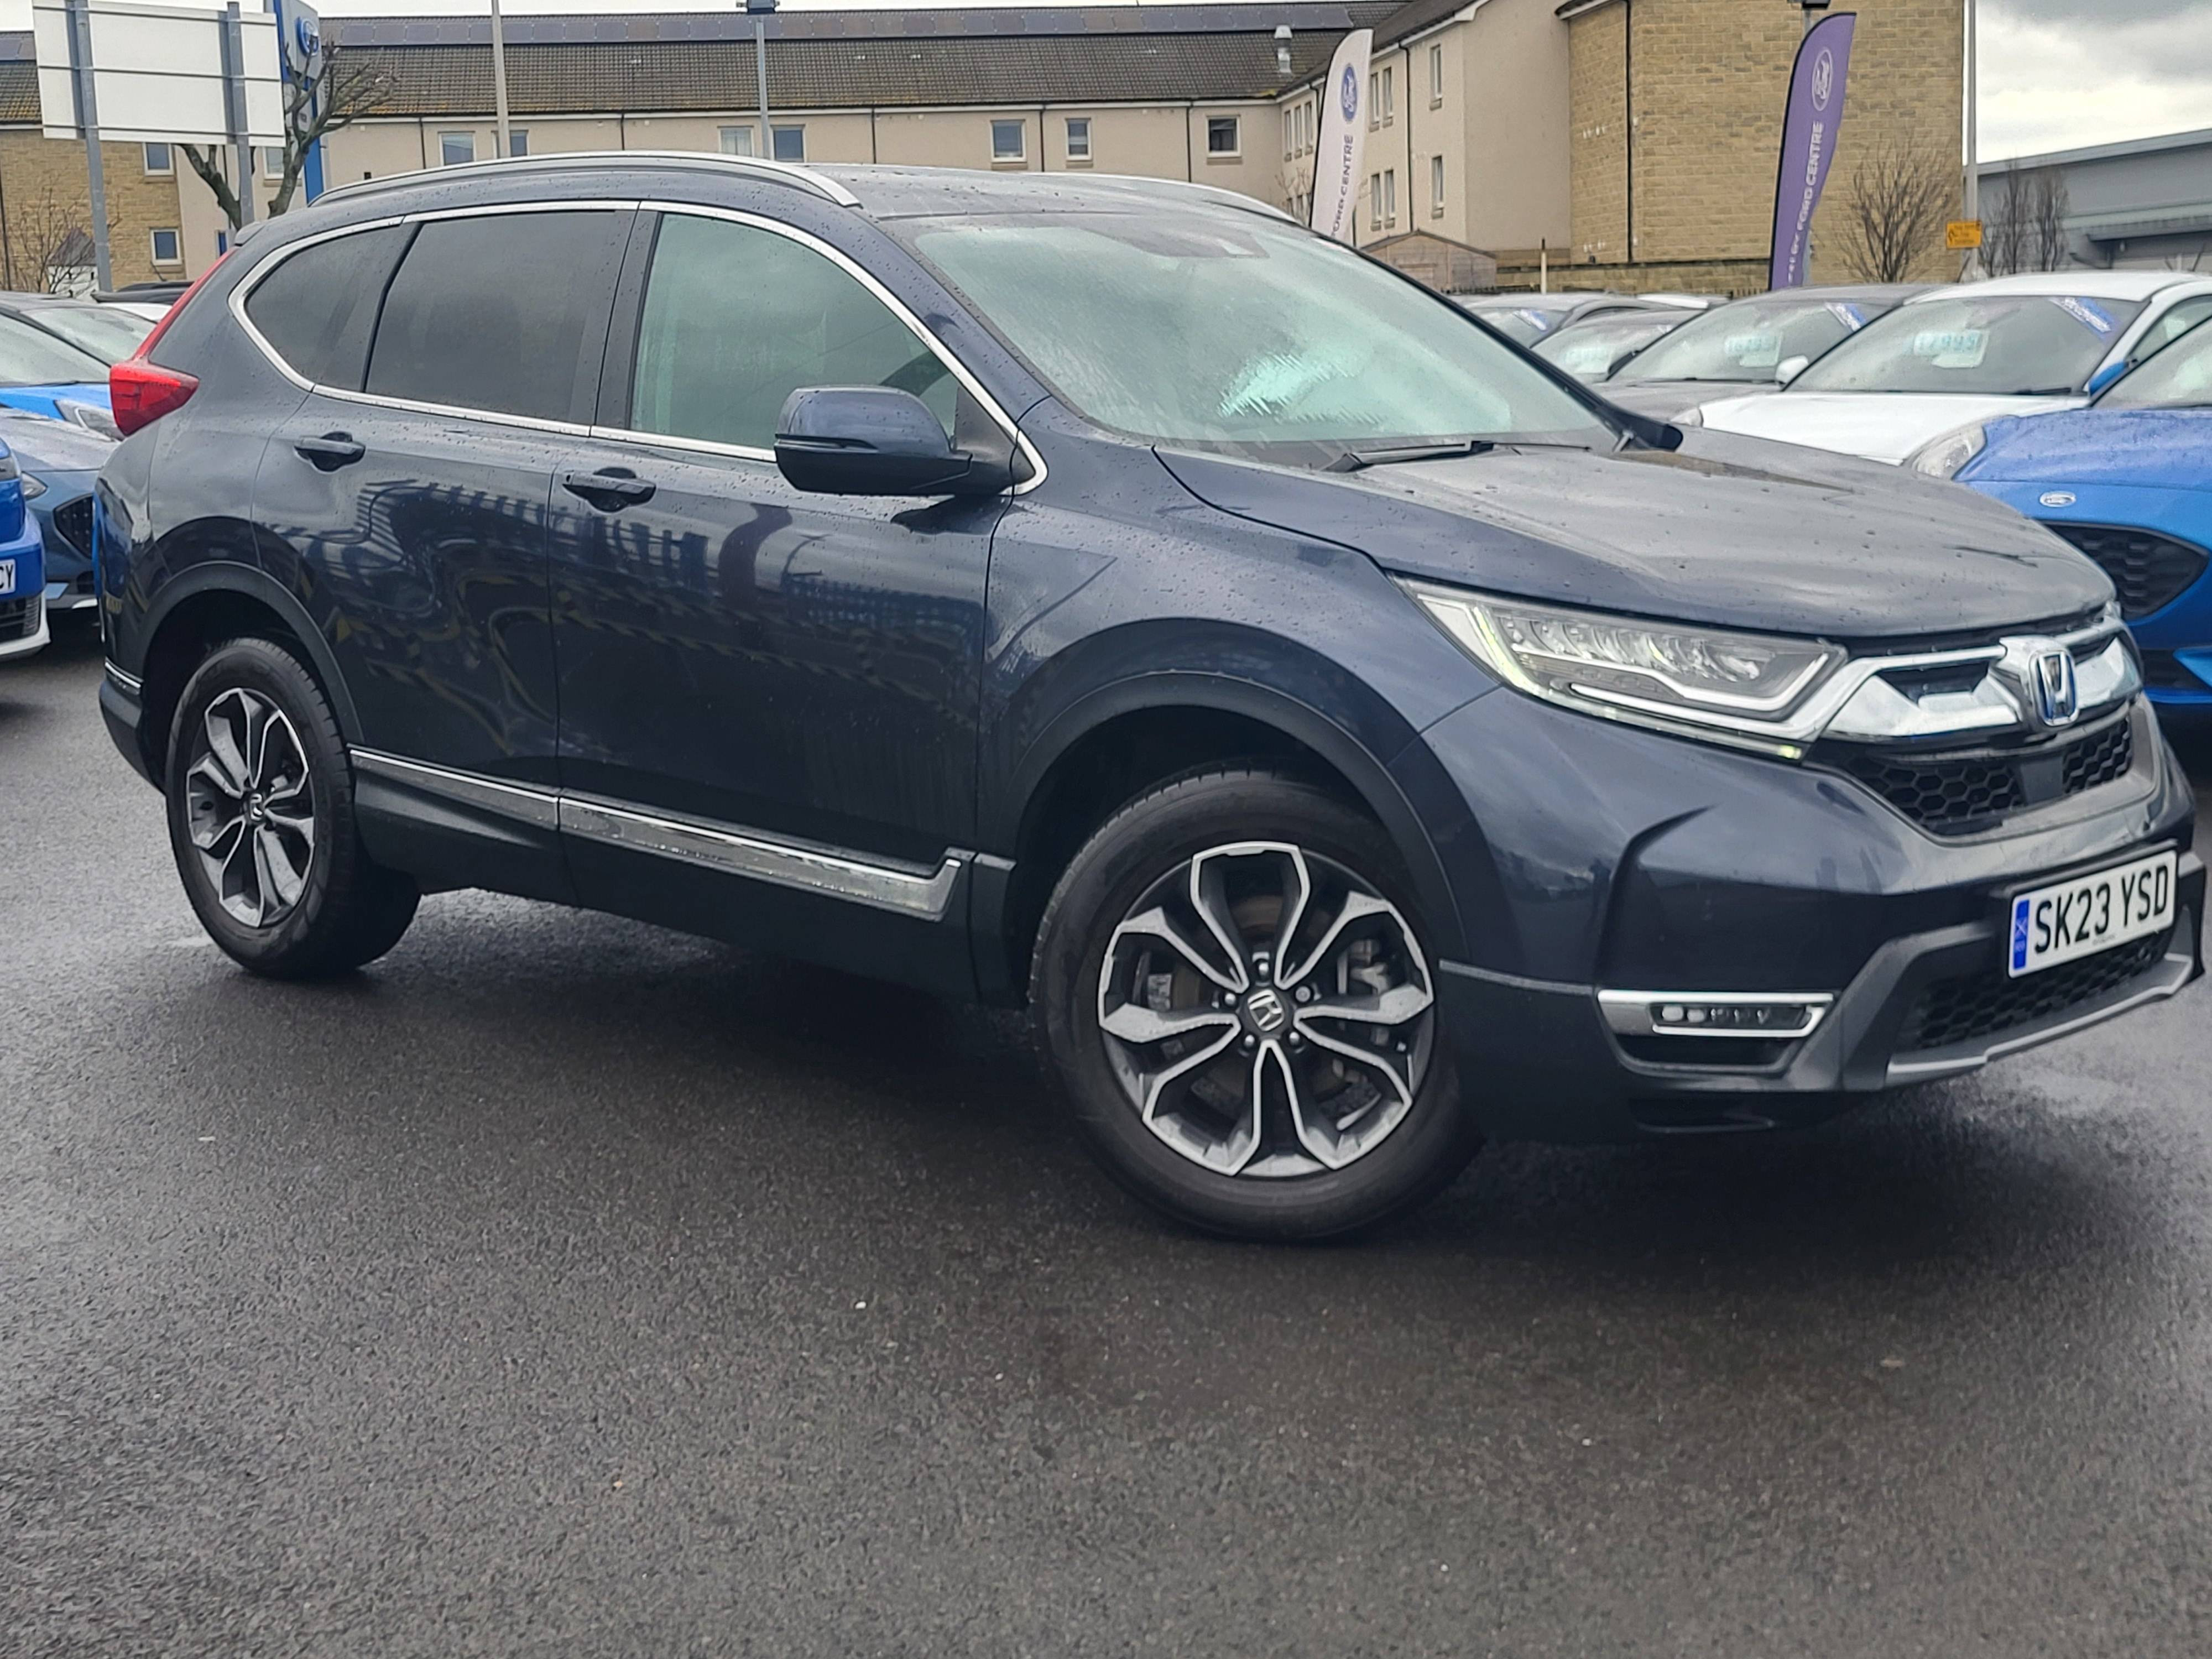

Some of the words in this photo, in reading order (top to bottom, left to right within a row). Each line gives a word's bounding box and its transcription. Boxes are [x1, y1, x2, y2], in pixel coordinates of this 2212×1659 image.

[1340, 134, 1353, 195] CENTRE
[1806, 121, 1824, 186] CENTRE
[2034, 883, 2110, 954] SK23
[2122, 864, 2168, 927] YSD
